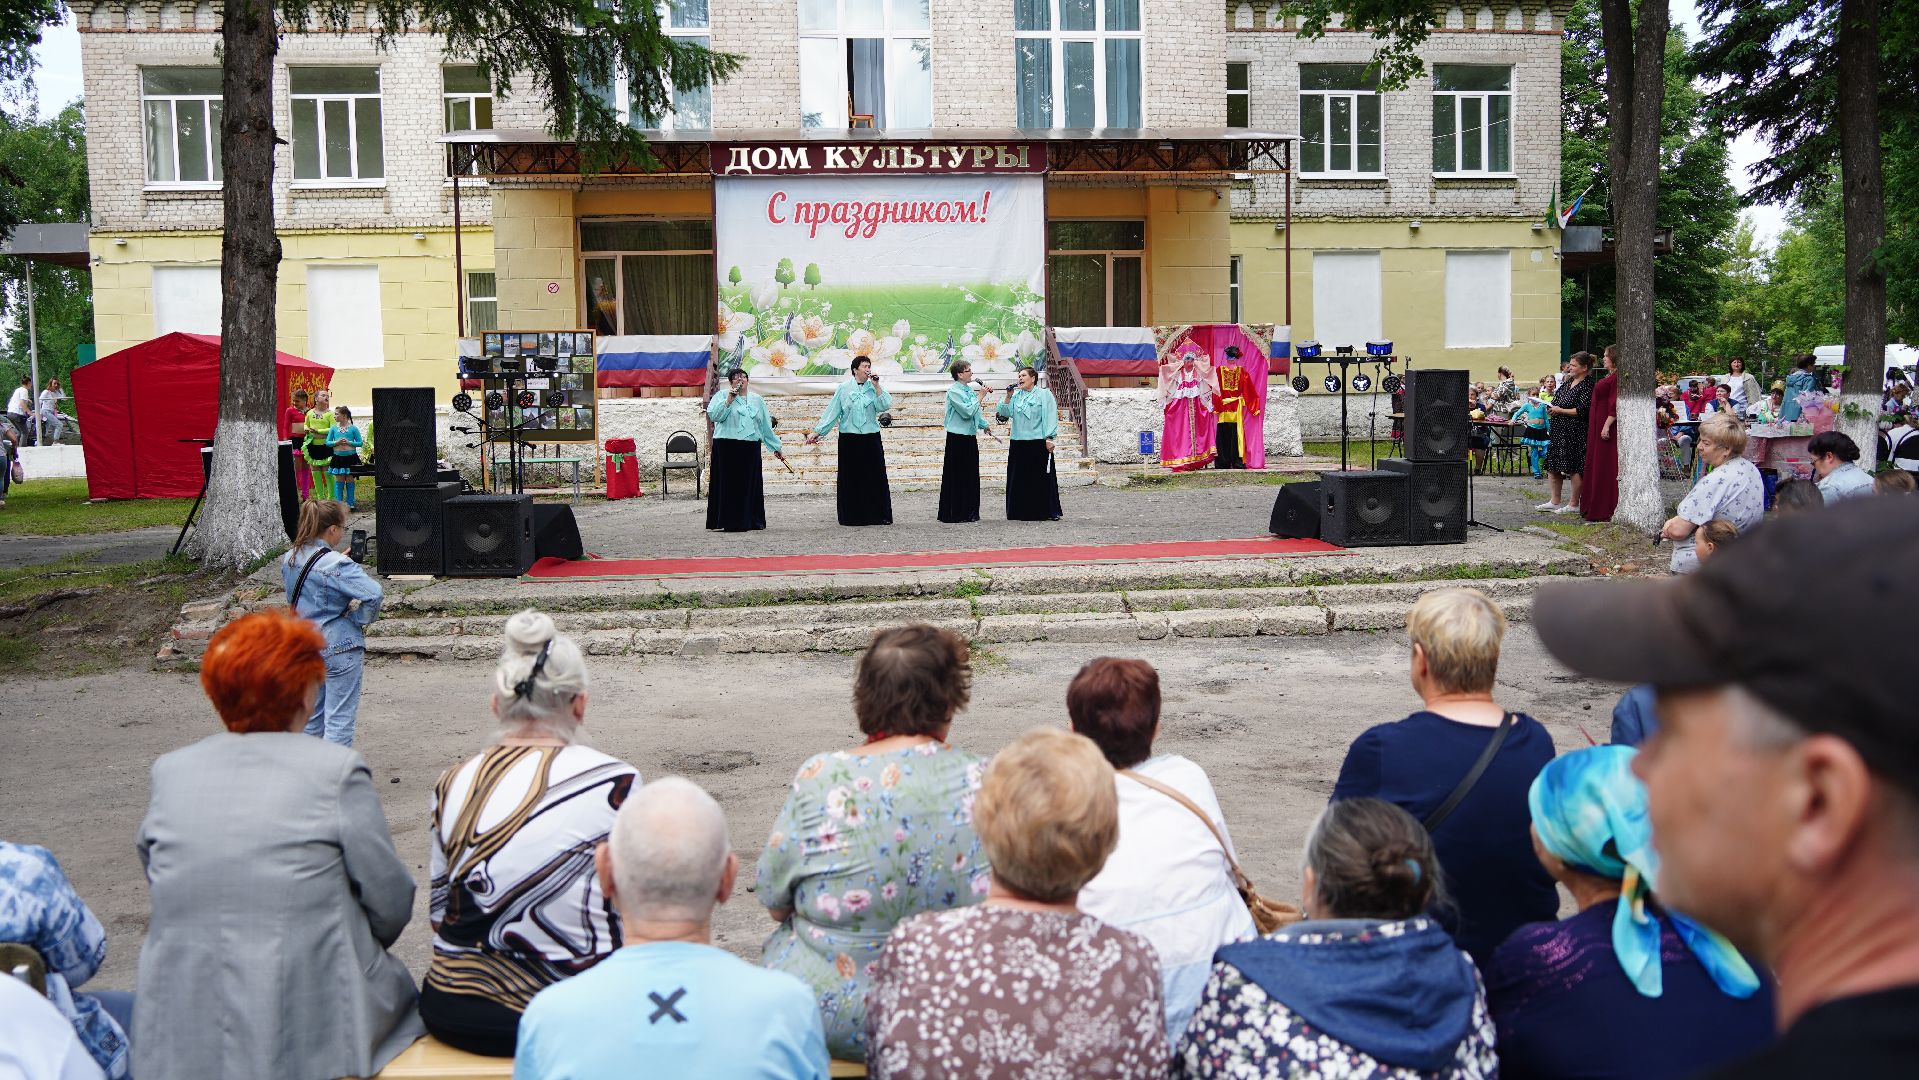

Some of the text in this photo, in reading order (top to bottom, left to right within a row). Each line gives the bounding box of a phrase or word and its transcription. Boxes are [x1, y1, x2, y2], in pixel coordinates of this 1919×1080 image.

[724, 145, 1030, 175] ДОМ КУЛЬТУРЫ
[767, 191, 991, 239] С праздником!
